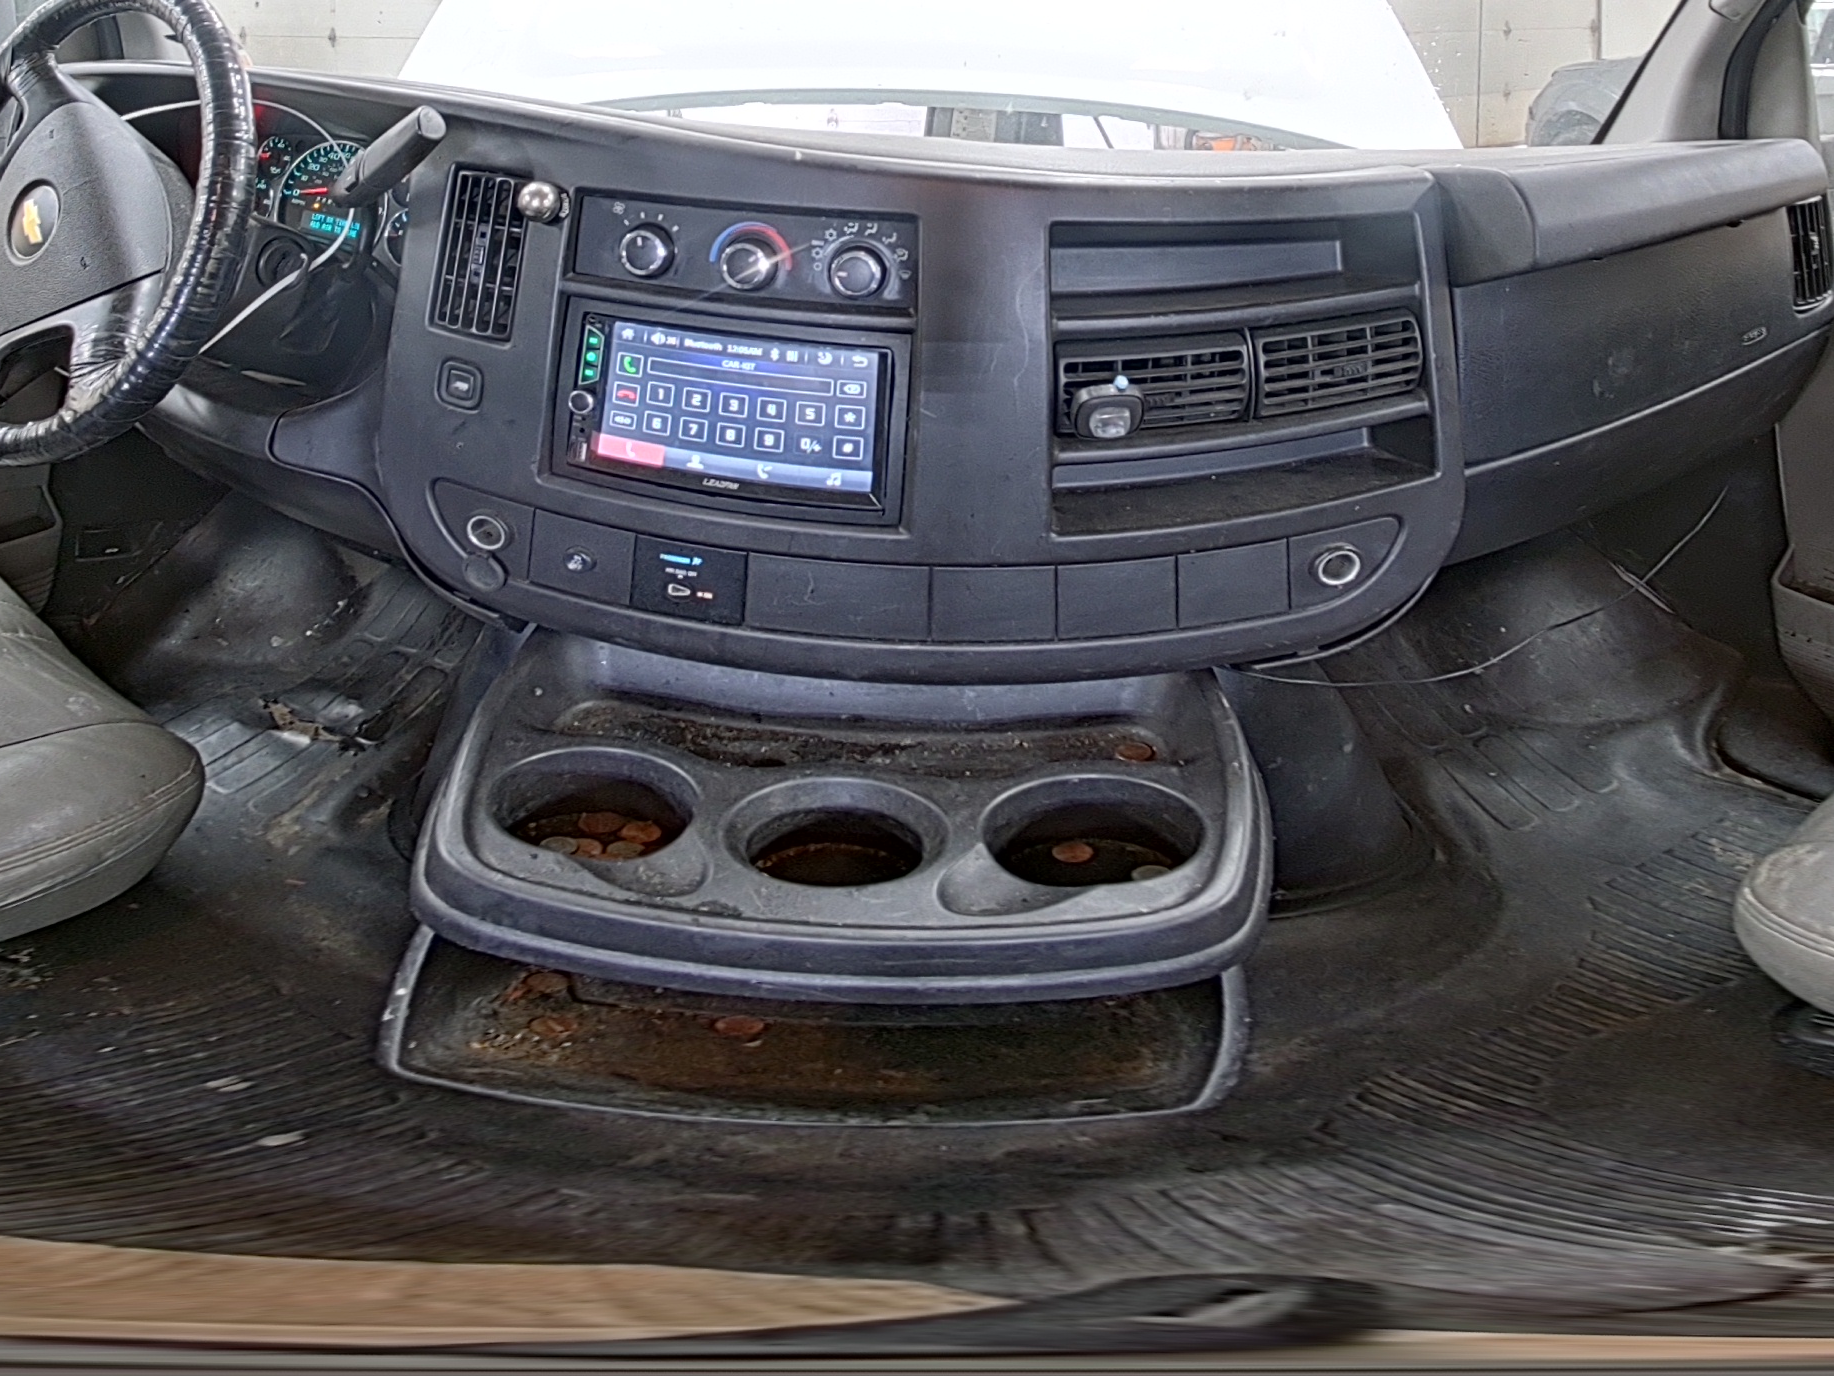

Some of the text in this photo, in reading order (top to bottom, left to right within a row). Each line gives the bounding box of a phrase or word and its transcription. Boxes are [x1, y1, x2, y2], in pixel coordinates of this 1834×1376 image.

[292, 188, 301, 196] 0
[684, 338, 723, 351] Bluetooth
[691, 393, 702, 405] 2
[728, 398, 739, 411] 3
[765, 403, 777, 416] 4
[805, 408, 816, 420] 5
[651, 417, 662, 429] 6
[688, 423, 699, 435] 7
[725, 429, 736, 441] 8
[764, 434, 775, 446] 9
